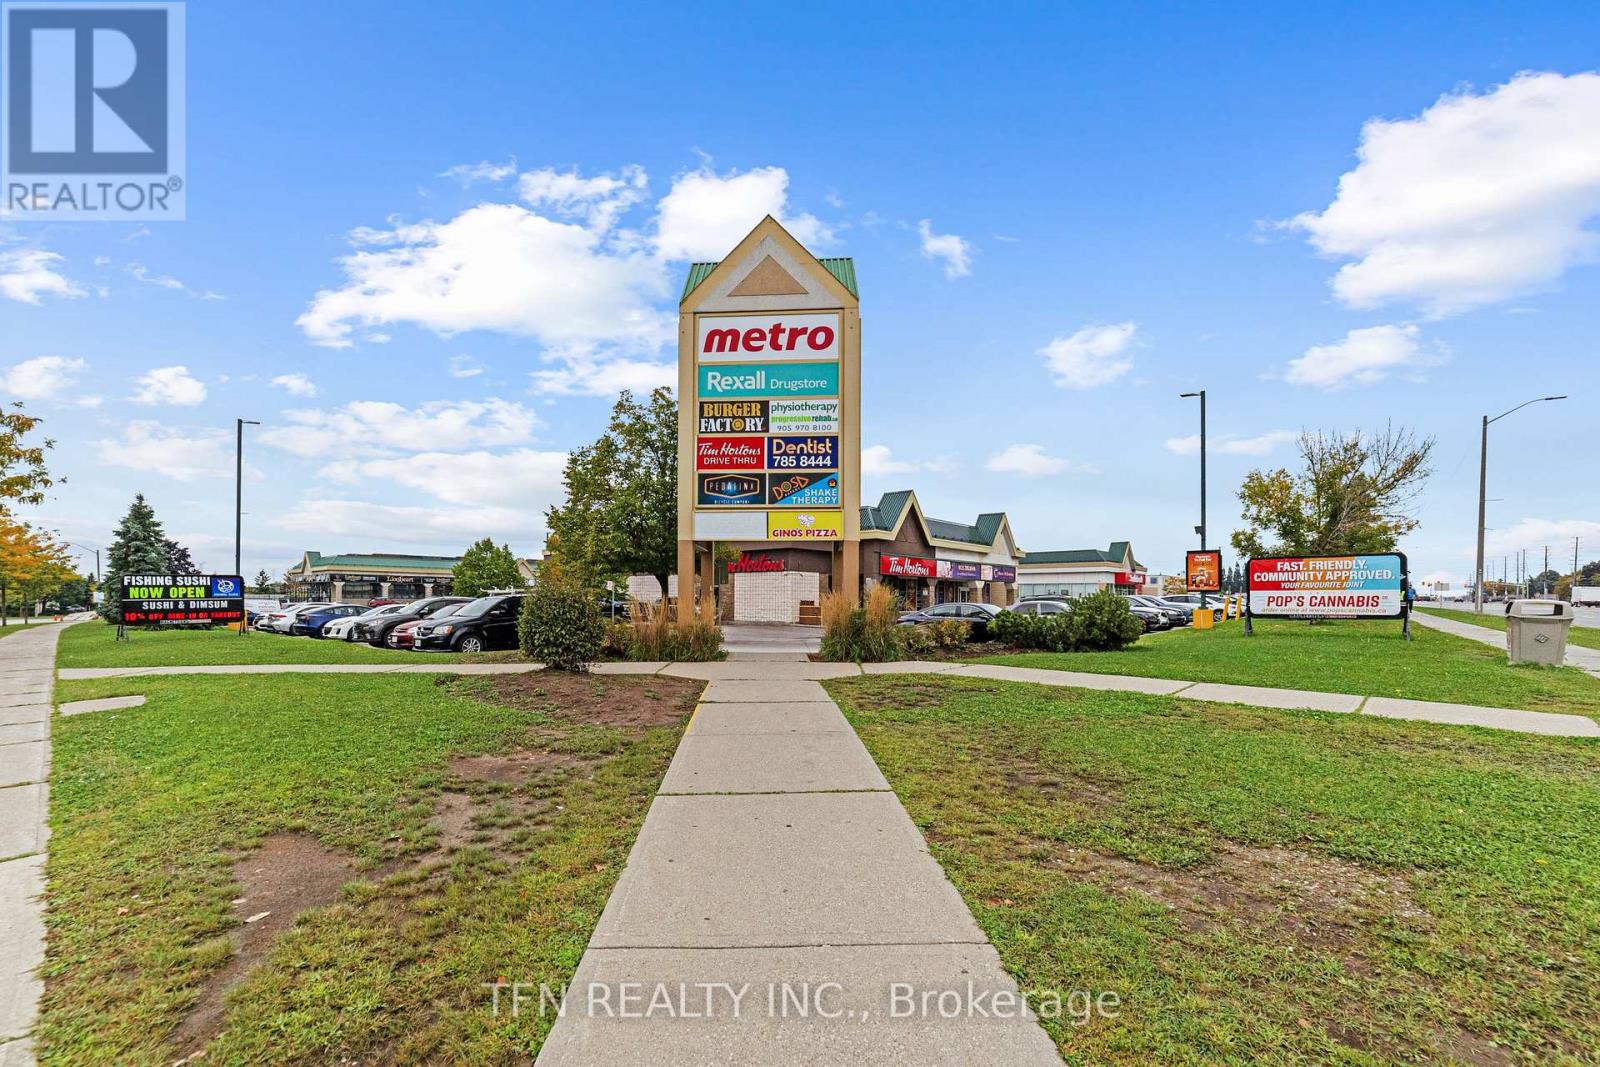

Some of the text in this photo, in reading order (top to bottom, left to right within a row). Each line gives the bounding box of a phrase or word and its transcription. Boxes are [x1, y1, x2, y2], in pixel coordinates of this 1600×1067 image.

[703, 323, 834, 352] metro
[707, 371, 827, 392] Rexall Drugstore
[703, 402, 761, 417] BURGER
[771, 402, 837, 414] physiotherapy
[700, 417, 764, 432] FACTORY
[699, 442, 761, 456] Tim Hortons
[772, 439, 832, 454] Dentist
[704, 457, 730, 465] DRIVE
[773, 455, 832, 467] 785 8444
[805, 489, 838, 497] SHAKE
[792, 496, 838, 504] THERAPY
[772, 528, 838, 537] GINO'S PIZZA
[889, 557, 930, 576] Tim Hortons
[1277, 560, 1367, 571] FAST. FRIENDLY.
[123, 576, 211, 586] FISHING SUSHI
[1254, 569, 1395, 582] COMMUNITY APPROVED.
[129, 587, 205, 599] NOW OPEN
[142, 601, 228, 610] SUSHI & DIMSUM
[1267, 596, 1305, 607] POP'S
[1309, 595, 1380, 607] CANNABIS
